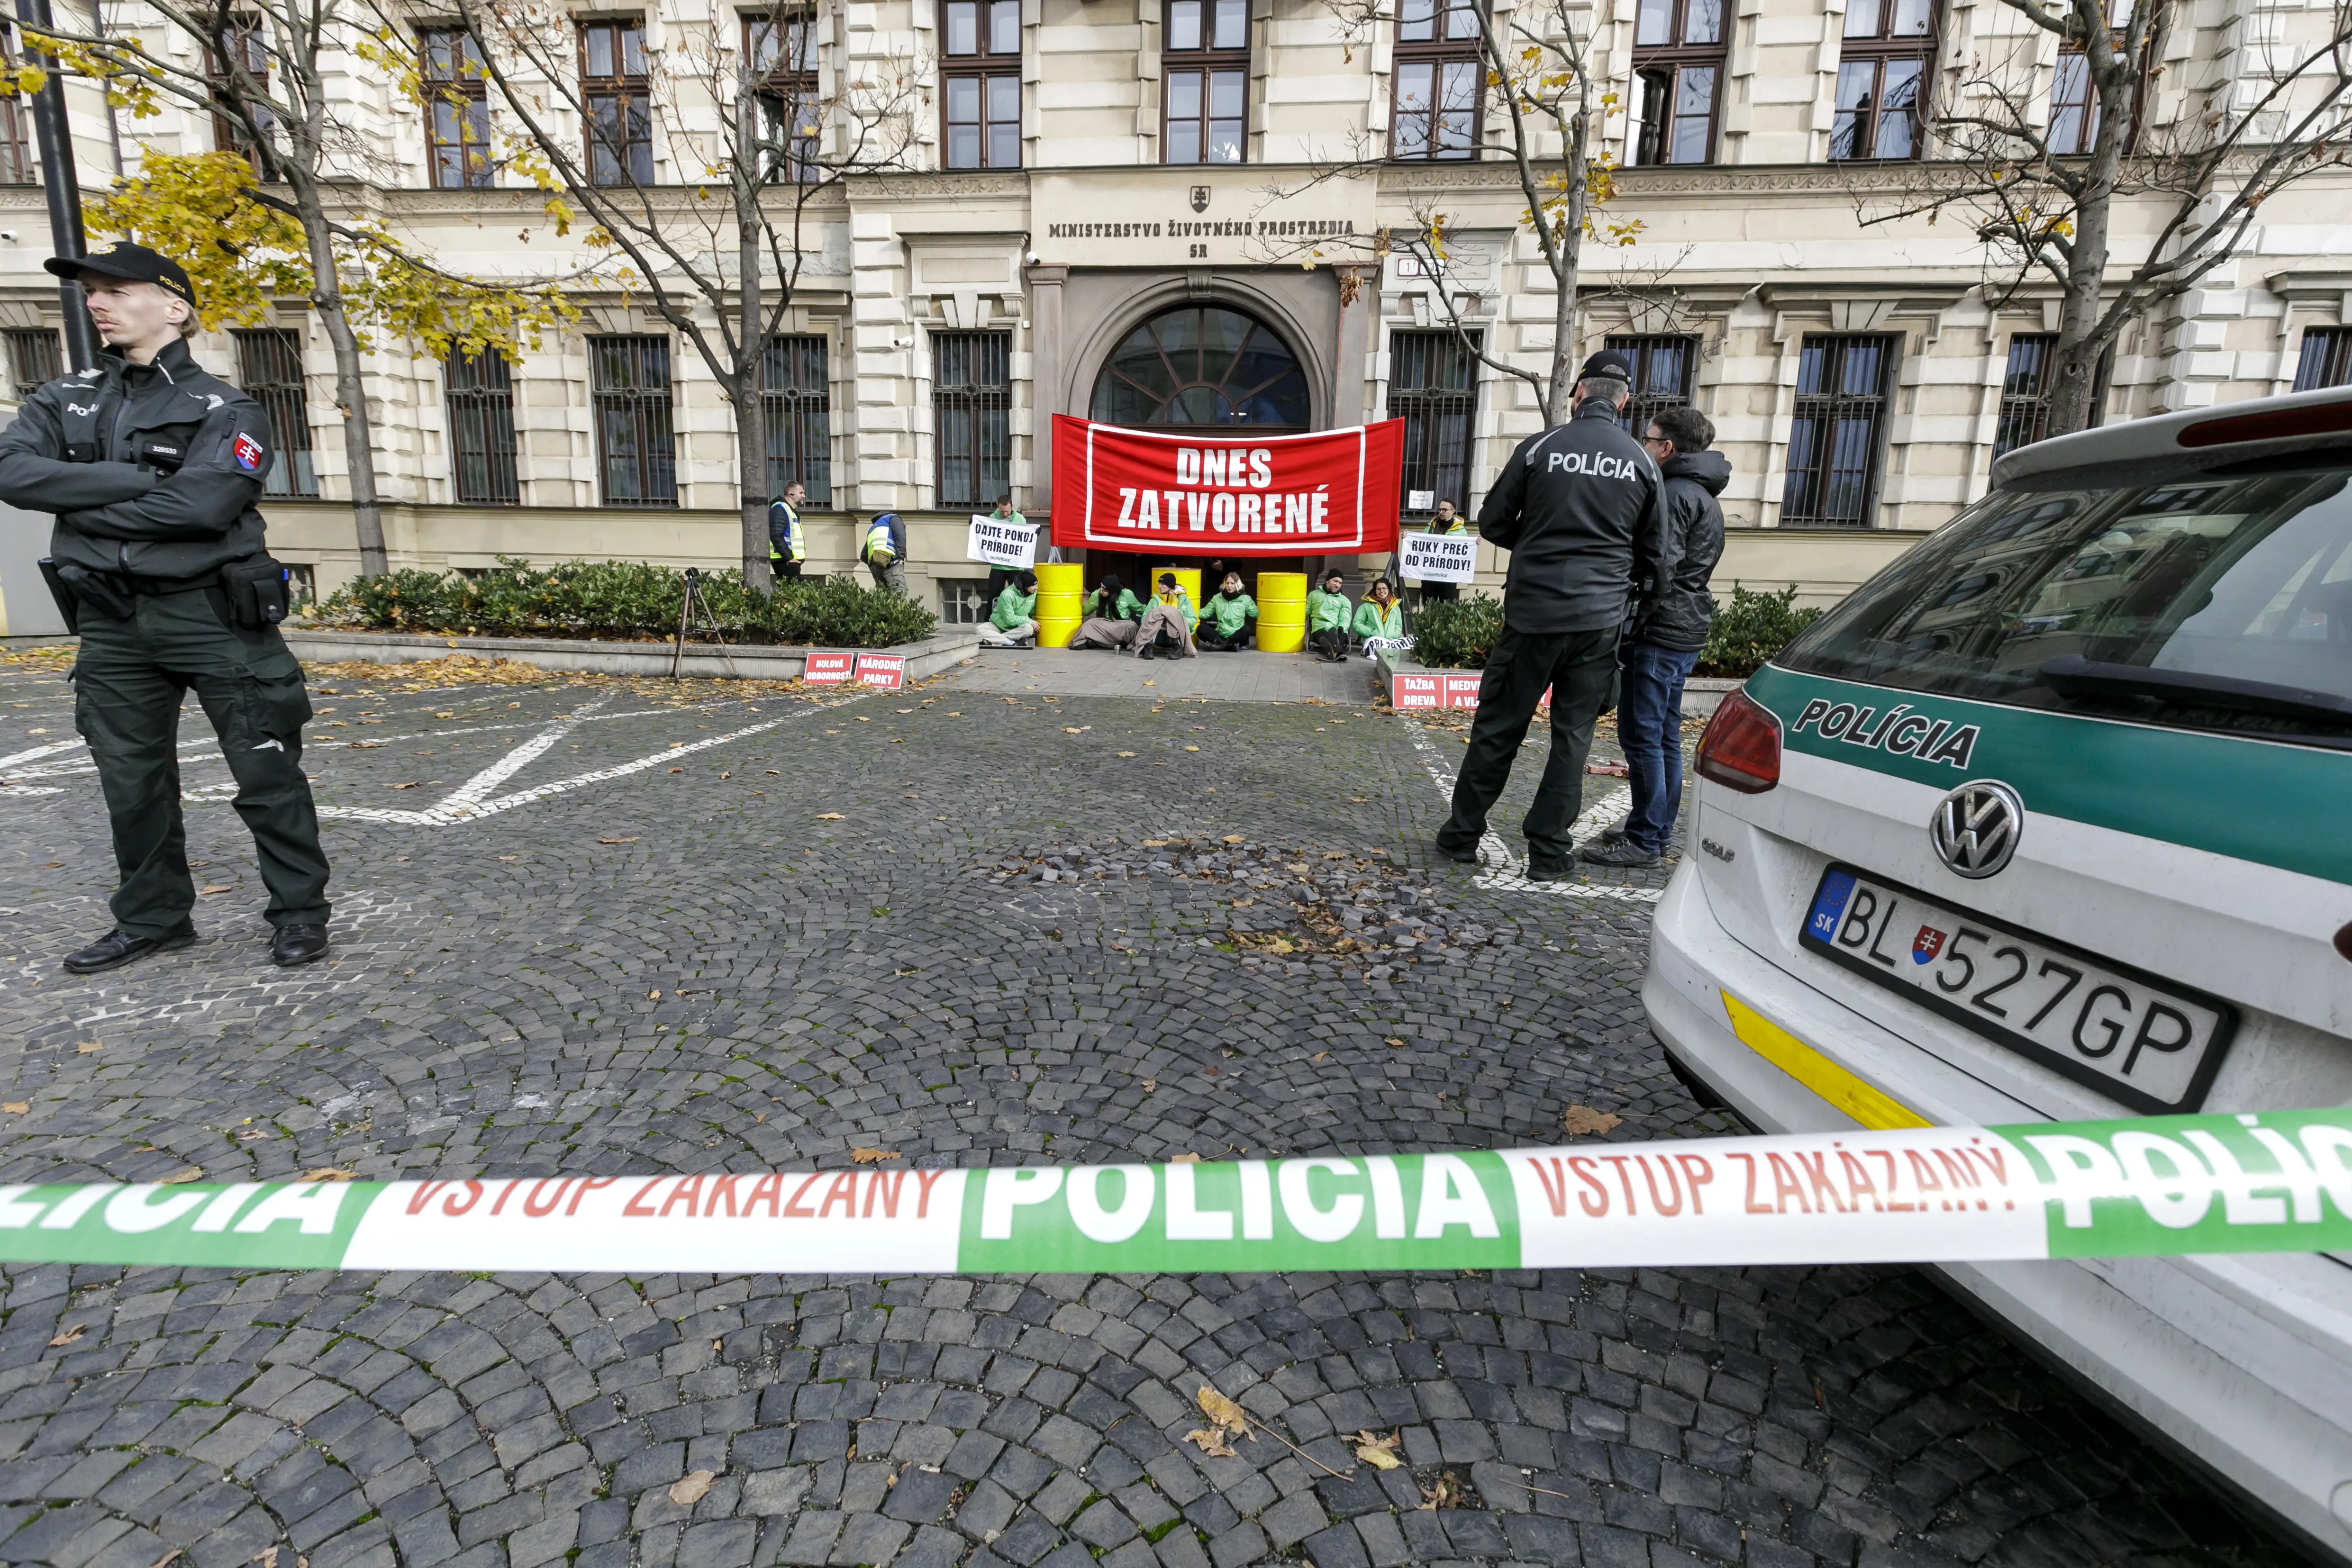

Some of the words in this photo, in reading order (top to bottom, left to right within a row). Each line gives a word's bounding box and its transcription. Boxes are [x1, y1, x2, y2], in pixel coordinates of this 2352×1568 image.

[1049, 223, 1161, 237] MINISTERSTVO
[1168, 218, 1253, 236] ŽIVOTNÉHO
[1259, 220, 1354, 236] PROSTREDIA
[1190, 244, 1208, 258] SR
[1177, 448, 1271, 489] DNES
[1547, 451, 1636, 481] POLÍCIA
[1118, 484, 1329, 534] ZATVORENÉ
[975, 523, 1001, 538] DAJTE
[1005, 529, 1034, 543] POKOJ
[981, 539, 1023, 556] PRÍRODE!
[1412, 540, 1439, 553] RUKY
[1442, 543, 1468, 556] PREČ
[1405, 554, 1419, 566] OD
[1423, 555, 1471, 571] PRÍRODY!
[816, 659, 844, 668] NULOVÁ
[859, 657, 903, 671] NÁRODNÉ
[807, 670, 850, 680] ODBORNOSŤ
[863, 673, 894, 685] PARKY
[1404, 678, 1435, 690] ŤAŽBA
[1403, 695, 1436, 706] DREVA
[1454, 696, 1462, 707] A
[1791, 698, 1980, 770] POLÍCIA
[1701, 837, 1735, 863] GOLF
[1815, 913, 1834, 932] SK
[1837, 886, 1898, 968] BL
[1936, 925, 2194, 1077] 527GP
[1526, 1152, 1714, 1218] VSTUP
